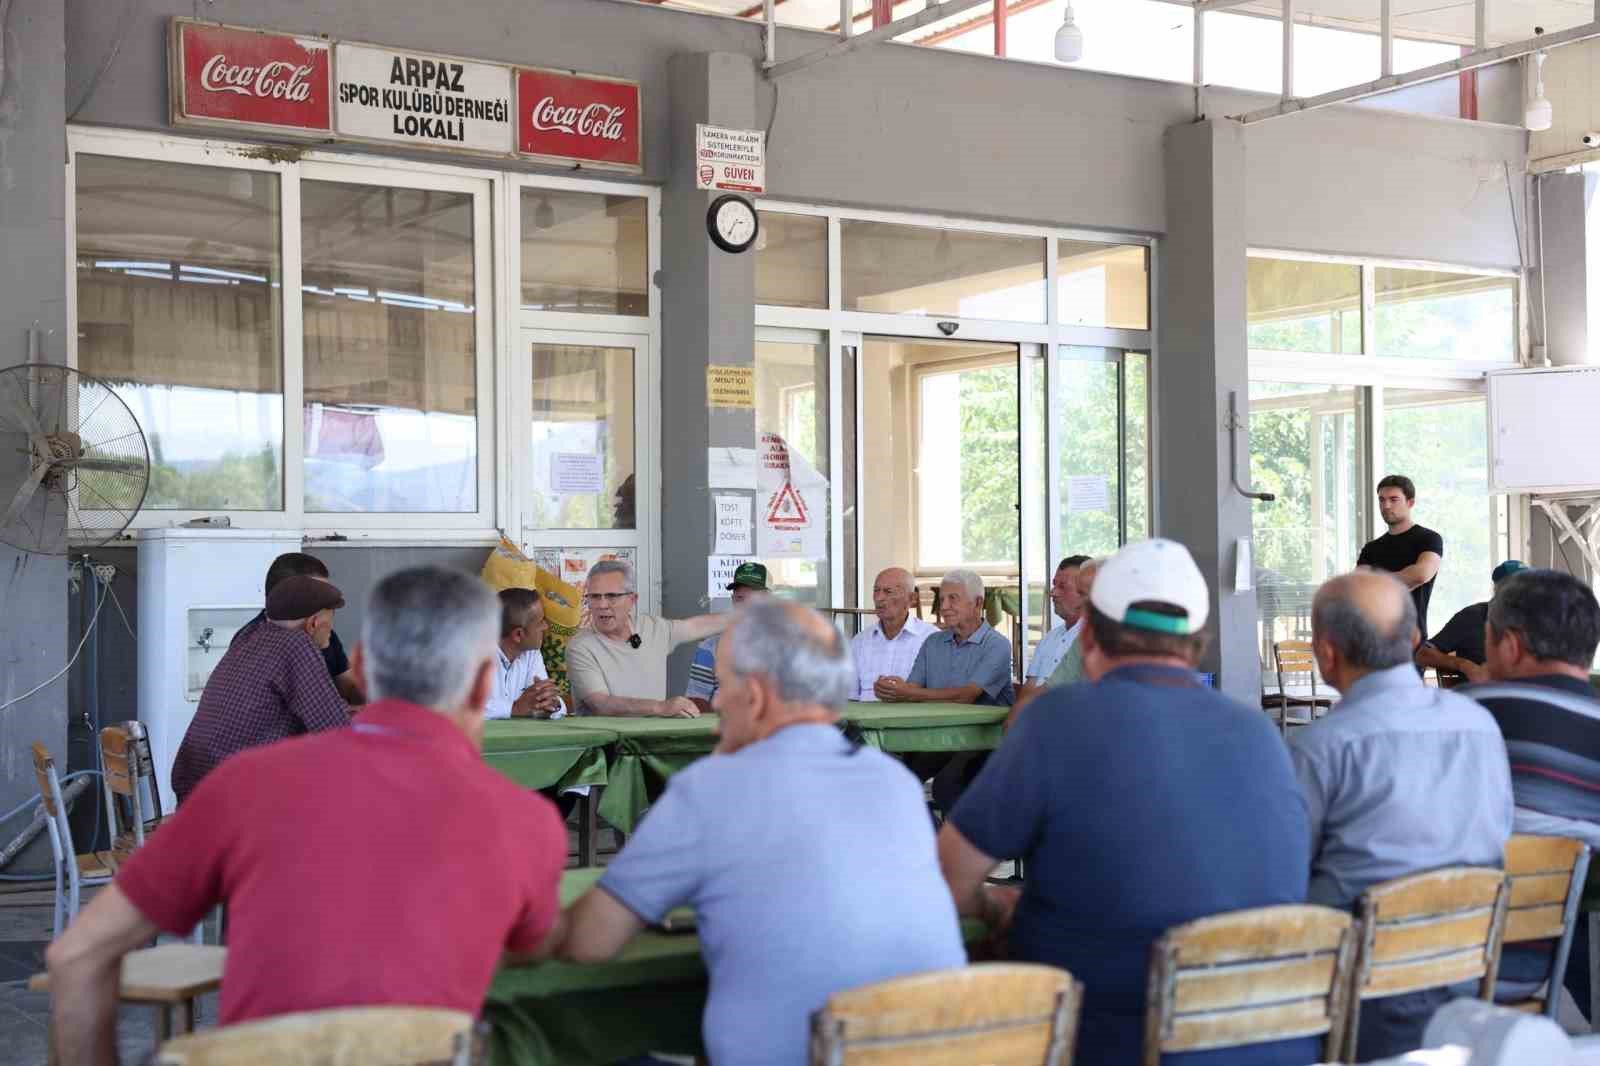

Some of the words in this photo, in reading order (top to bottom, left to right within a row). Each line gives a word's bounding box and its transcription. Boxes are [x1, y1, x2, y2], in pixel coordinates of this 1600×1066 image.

[201, 54, 313, 102] Coca-Cola
[390, 56, 465, 93] ARPAZ
[340, 82, 379, 107] SPOR
[383, 88, 443, 115] KULÜBÜ
[446, 95, 509, 123] DERNEĞİ
[532, 96, 626, 140] Coca-Cola
[394, 114, 465, 141] LOKALİ
[737, 135, 759, 143] ALARM
[720, 504, 738, 513] TOST
